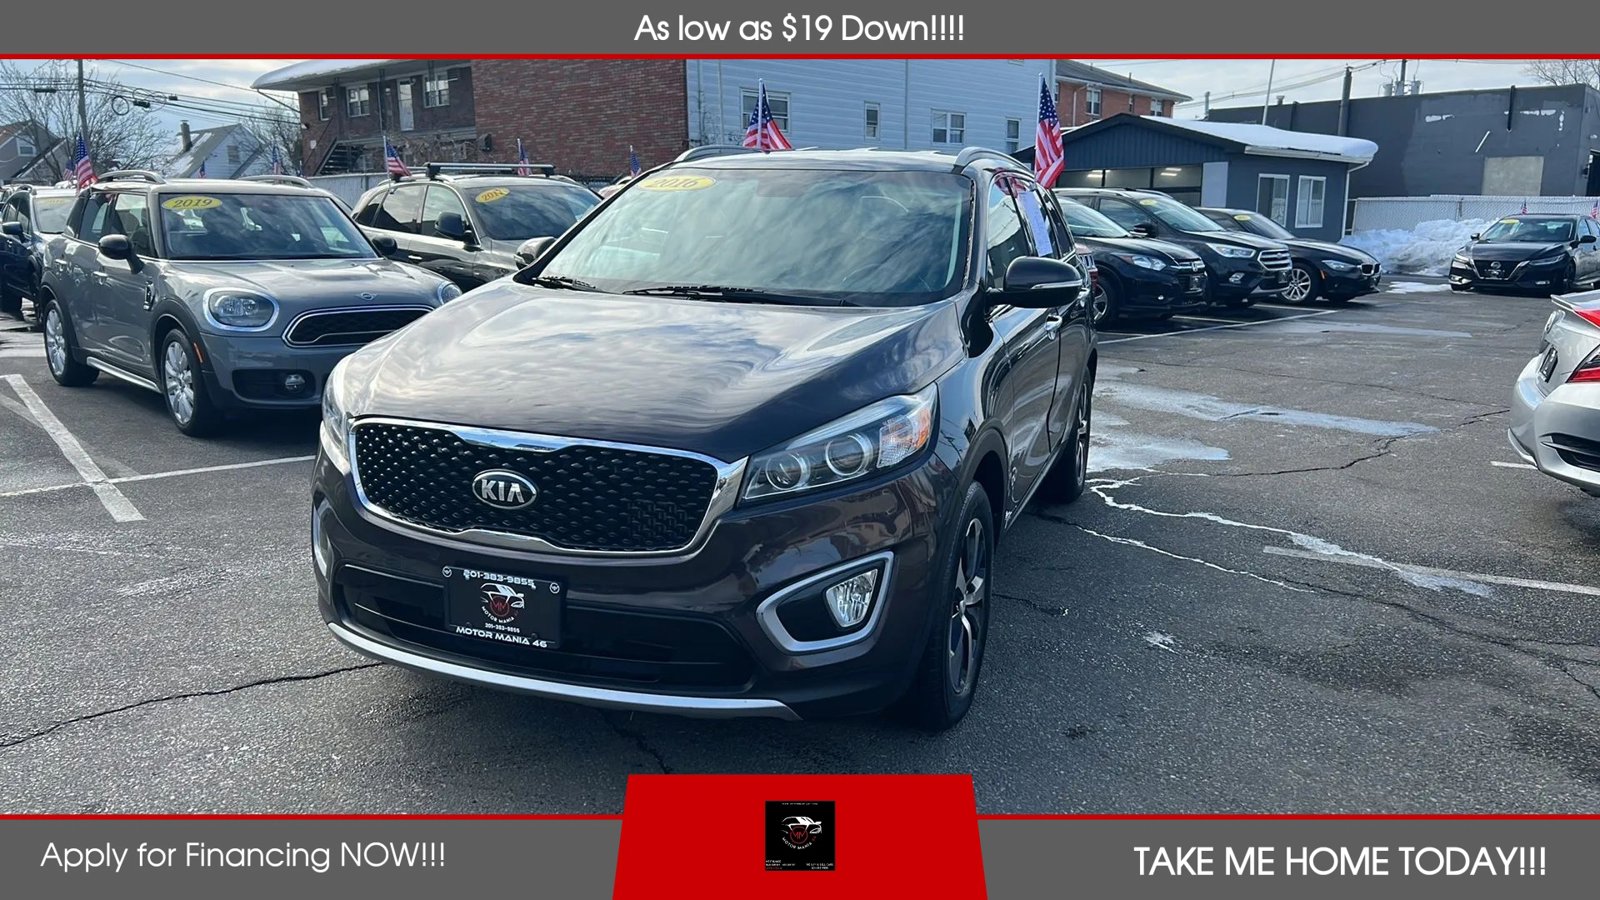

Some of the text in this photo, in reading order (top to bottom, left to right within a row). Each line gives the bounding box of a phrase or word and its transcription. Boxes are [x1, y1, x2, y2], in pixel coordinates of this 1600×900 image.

[653, 175, 704, 189] 2016
[172, 196, 213, 209] 2019
[481, 479, 526, 504] KIA
[462, 569, 535, 589] 201-383-9855
[481, 606, 498, 622] MOTOR
[455, 626, 548, 649] MOTOR MANIA 46
